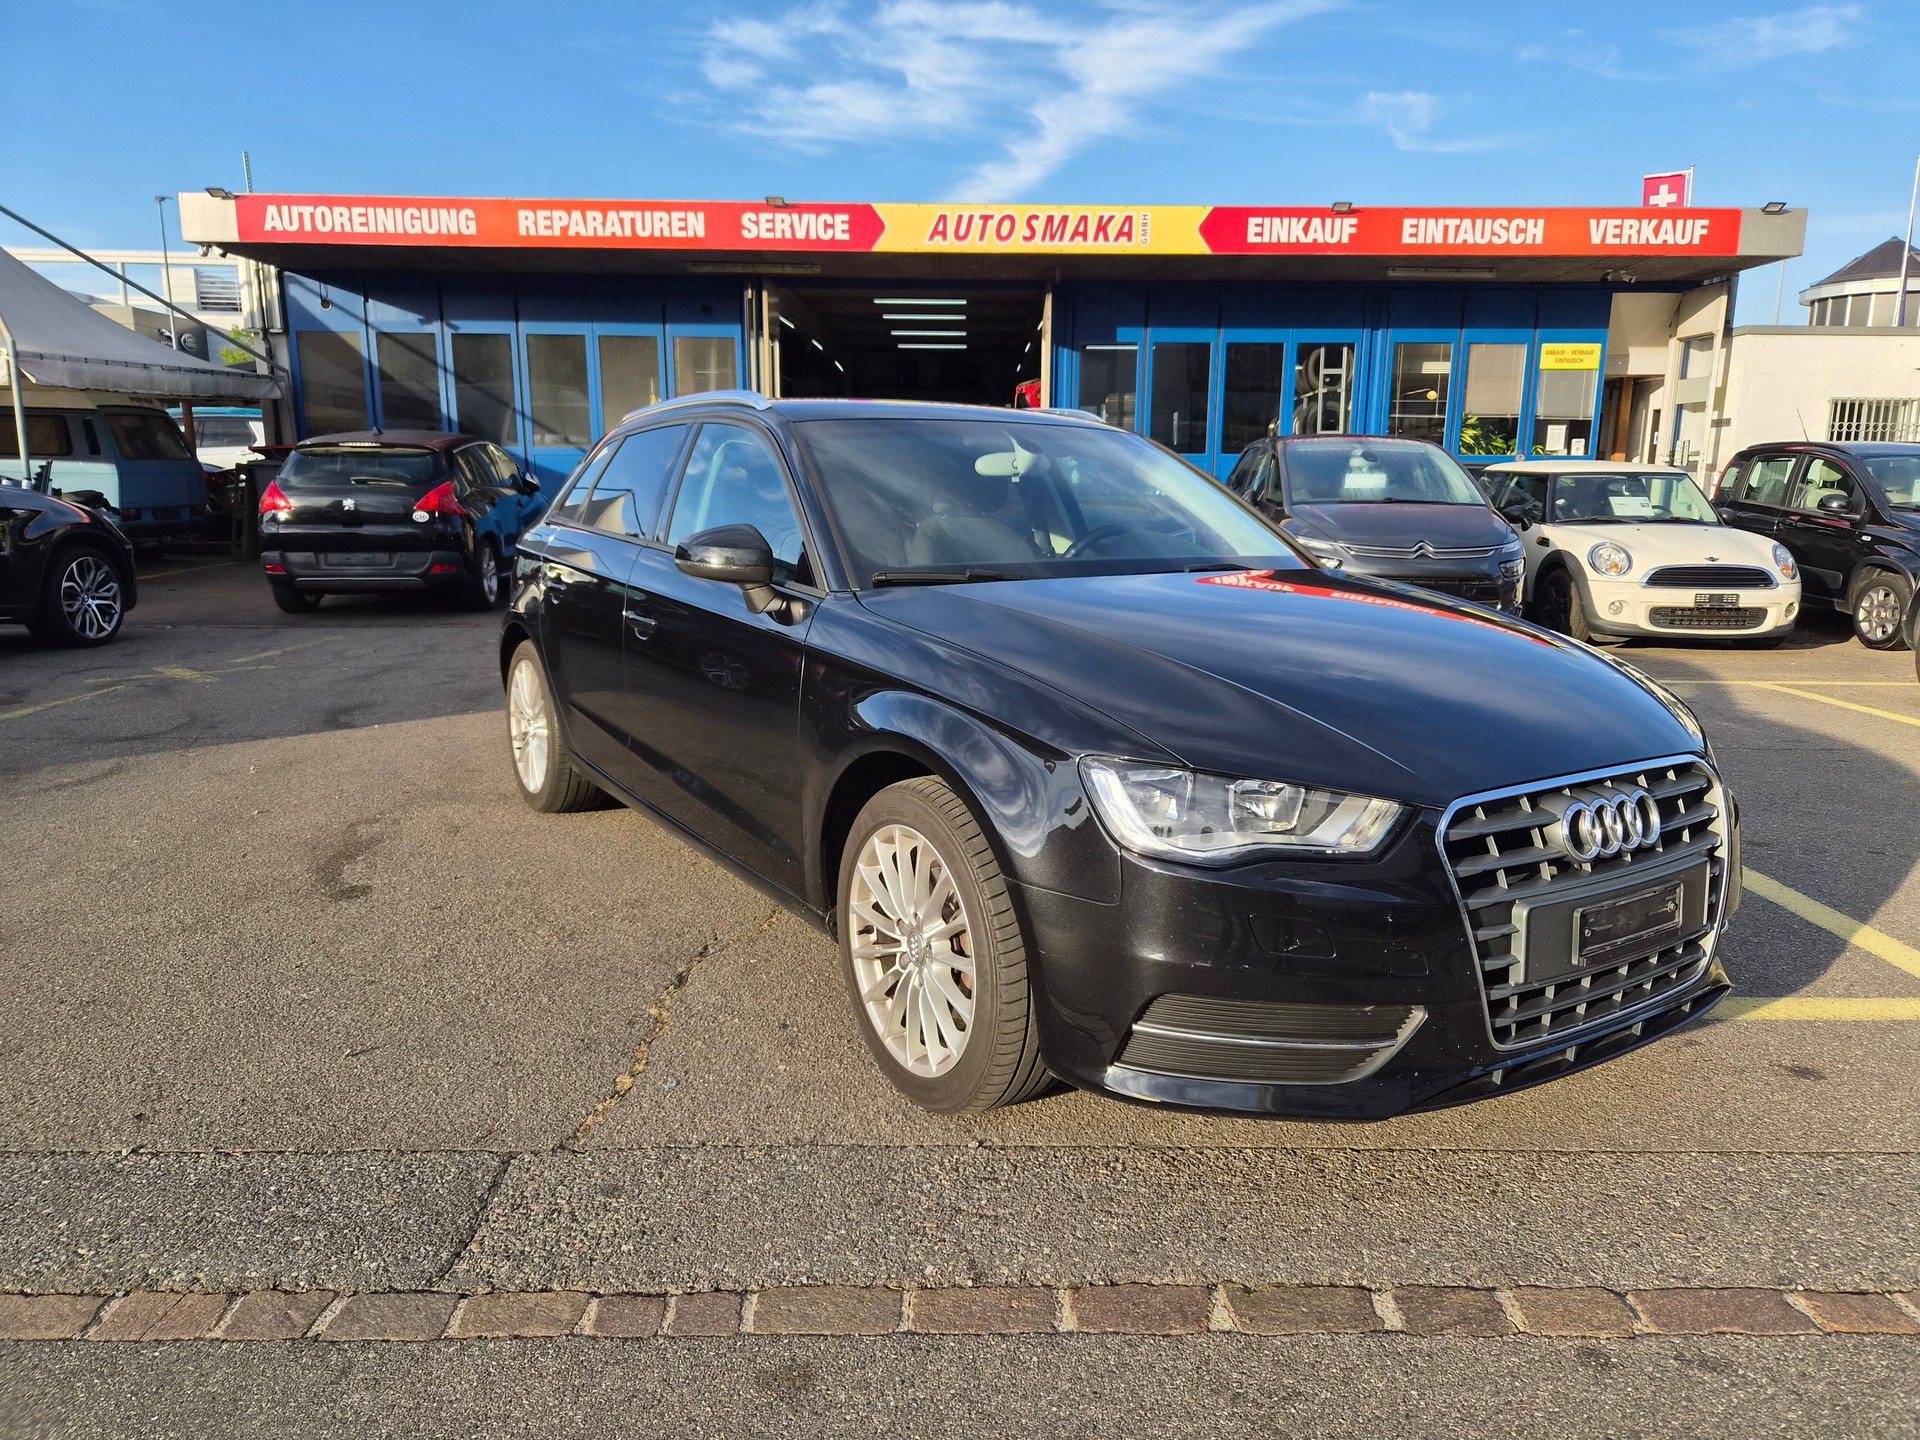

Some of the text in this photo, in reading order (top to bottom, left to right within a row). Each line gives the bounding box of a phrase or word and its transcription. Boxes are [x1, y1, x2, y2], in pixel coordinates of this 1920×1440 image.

[265, 205, 476, 234] AUTOREINIGUNG
[518, 210, 704, 237] REPARATUREN
[742, 213, 849, 240] SERVICE
[929, 215, 1132, 242] AUTO SMAKA
[1140, 213, 1148, 244] GMBH
[1248, 218, 1357, 243] EINKAUF
[1402, 219, 1544, 244] EINTAUSCH
[1590, 219, 1709, 244] VERKAUF
